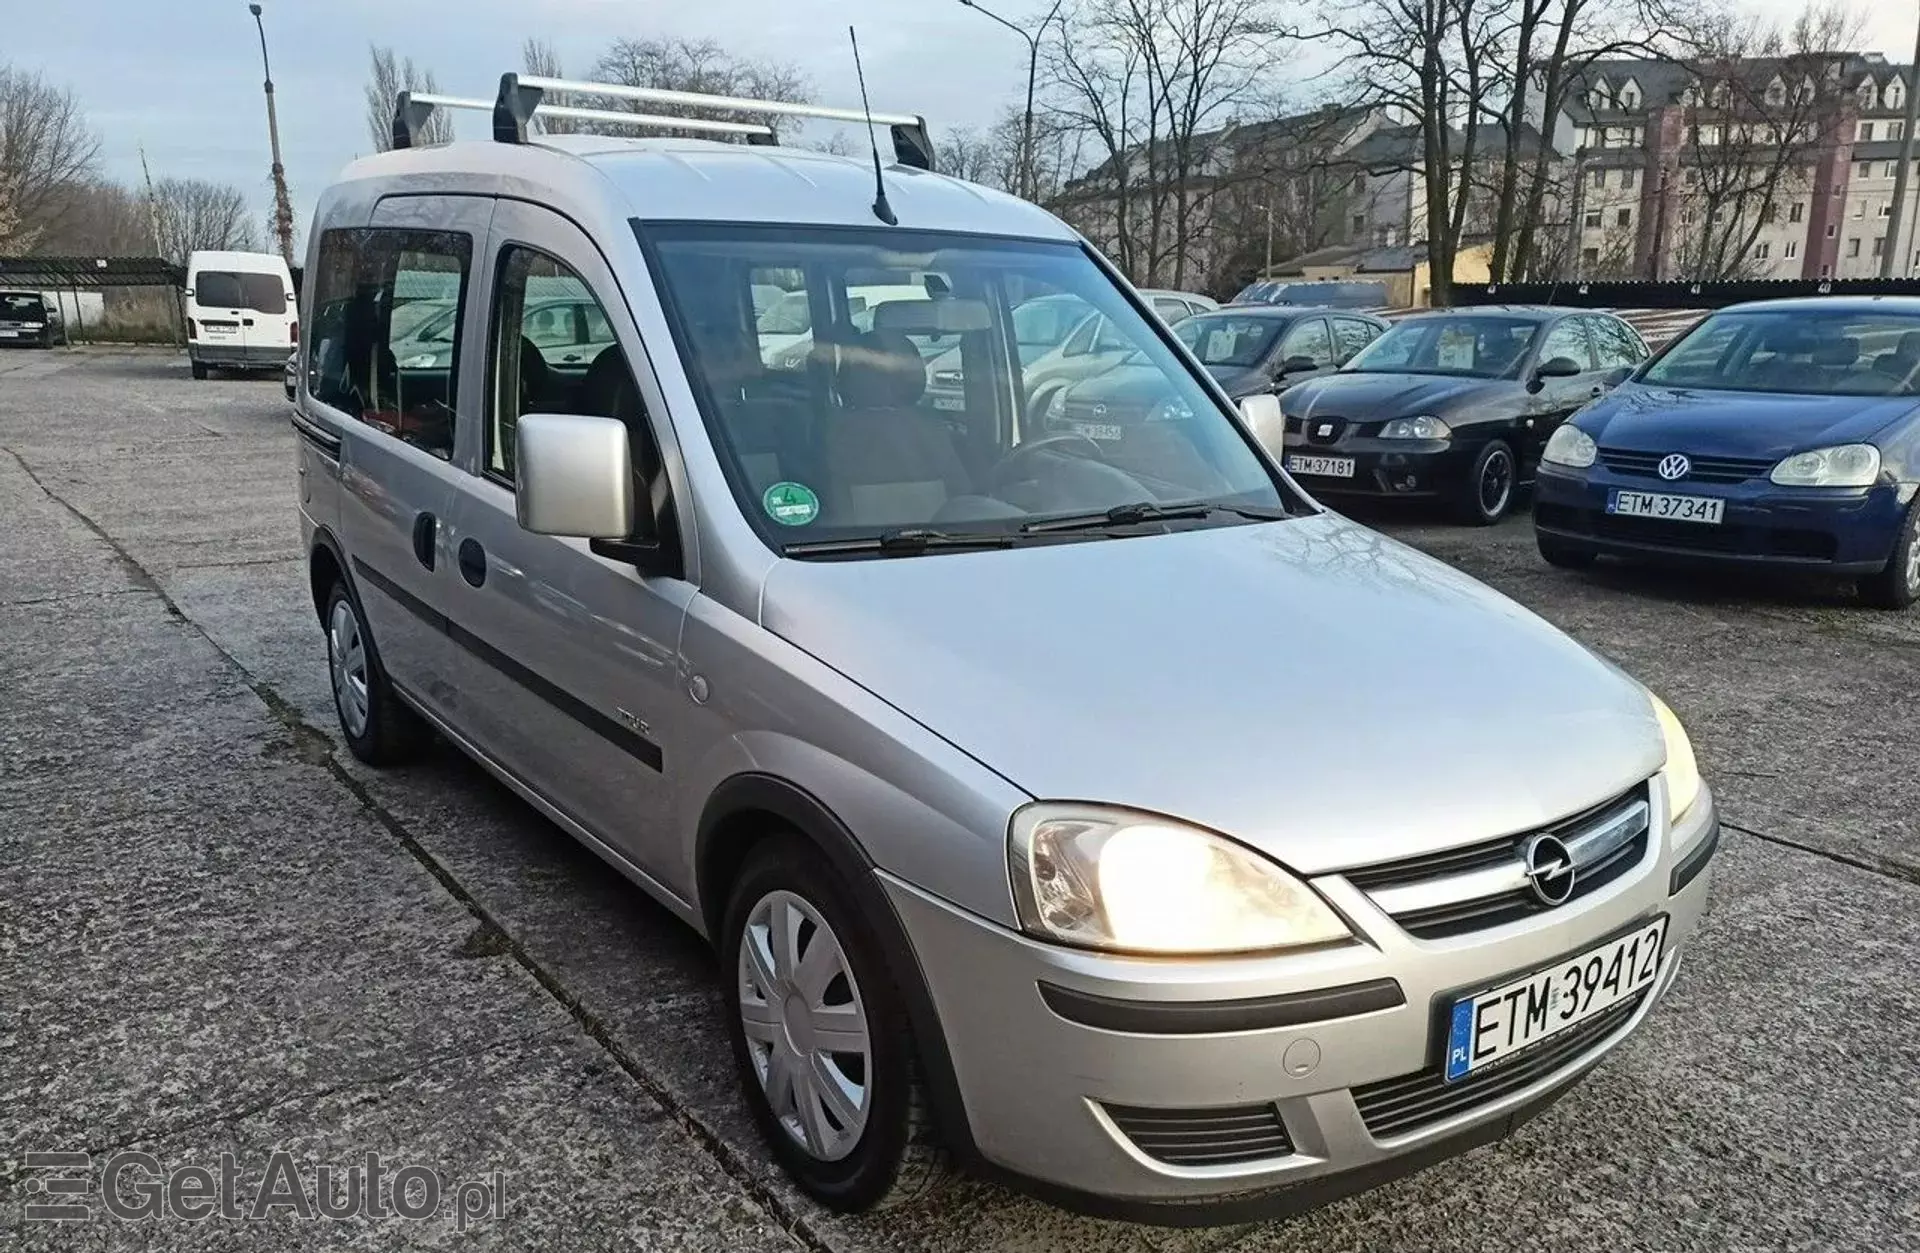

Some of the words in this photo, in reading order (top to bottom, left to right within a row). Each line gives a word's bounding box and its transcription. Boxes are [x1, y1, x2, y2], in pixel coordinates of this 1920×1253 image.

[1617, 493, 1653, 514] ETM
[1658, 498, 1717, 520] 37341
[1473, 976, 1551, 1061] ETM
[1560, 928, 1659, 1019] 39412
[1452, 1047, 1466, 1064] PL
